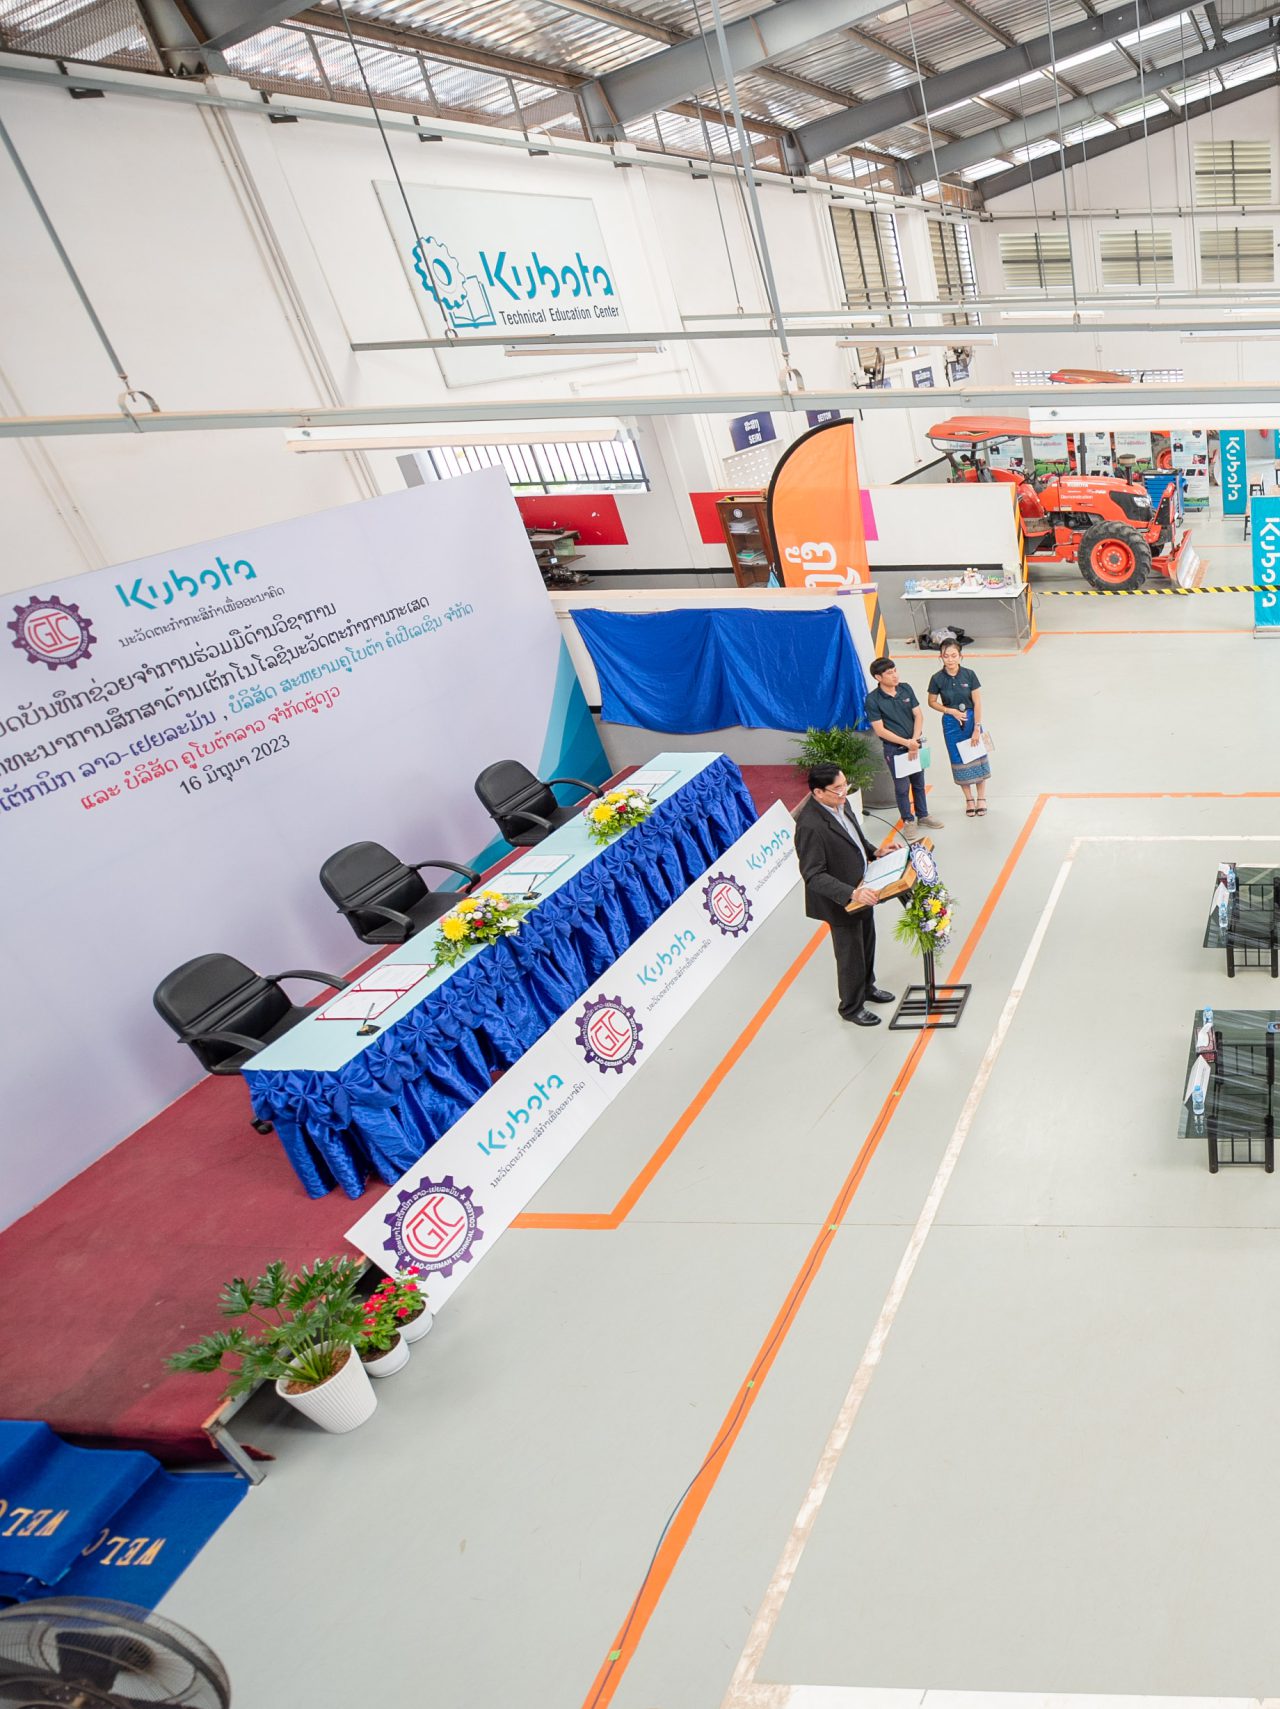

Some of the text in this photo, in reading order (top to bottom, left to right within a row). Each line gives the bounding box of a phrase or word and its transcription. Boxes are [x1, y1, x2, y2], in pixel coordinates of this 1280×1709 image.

[478, 251, 614, 300] Kubota
[499, 305, 619, 325] Technical Education Center
[1226, 436, 1241, 501] Kubota
[115, 556, 257, 610] Kubota
[1260, 517, 1280, 608] Kuboa
[179, 775, 202, 794] 16
[251, 734, 290, 761] 2023
[81, 785, 121, 810] ແລະ
[745, 829, 790, 870] Kubota
[636, 929, 696, 986] Kubota
[477, 1074, 564, 1156] Kubota
[452, 1230, 474, 1261] TECHNICAL
[464, 1201, 476, 1227] COLLEGE
